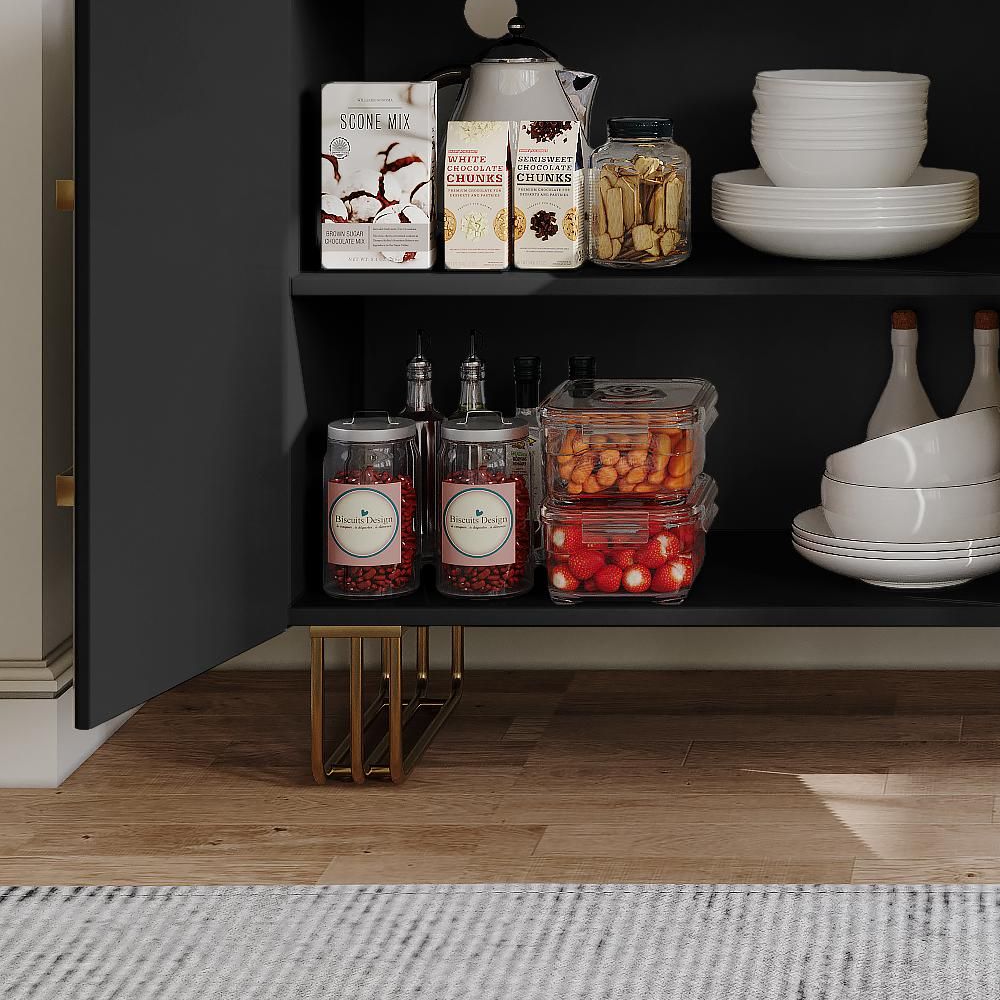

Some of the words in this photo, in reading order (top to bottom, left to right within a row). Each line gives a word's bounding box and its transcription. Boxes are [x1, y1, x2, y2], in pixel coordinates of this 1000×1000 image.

[340, 113, 382, 130] SCONE
[388, 113, 410, 130] MIX
[447, 155, 487, 163] WHITE
[446, 174, 503, 183] CHUNKS
[516, 173, 572, 183] CHUNKS
[335, 515, 365, 524] Biscuits
[366, 516, 393, 525] Design
[449, 515, 479, 524] Biscuits
[481, 516, 508, 525] Design
